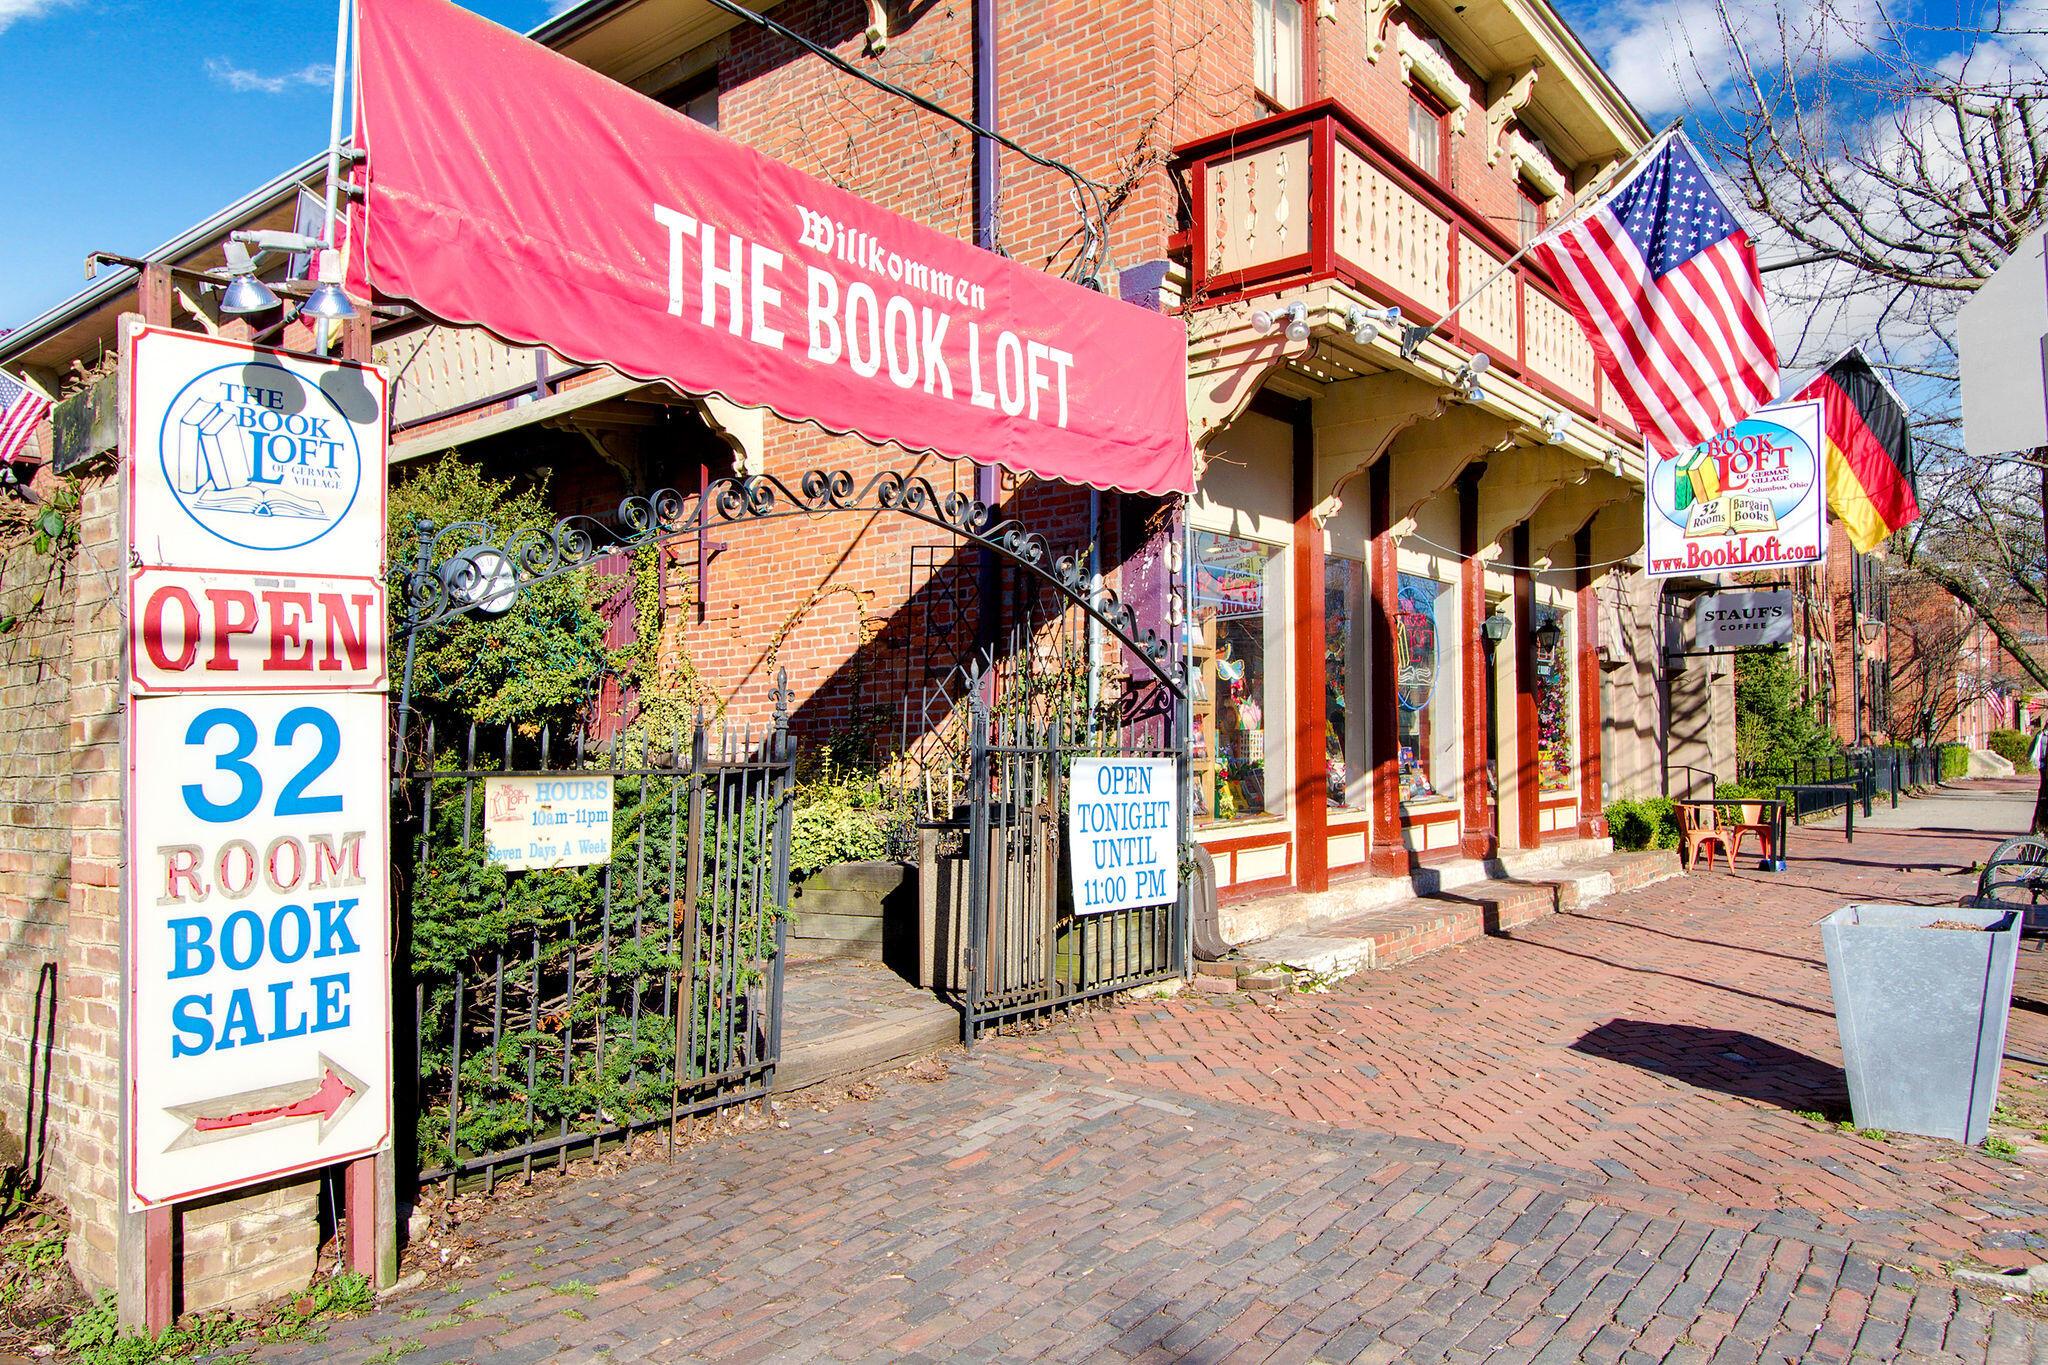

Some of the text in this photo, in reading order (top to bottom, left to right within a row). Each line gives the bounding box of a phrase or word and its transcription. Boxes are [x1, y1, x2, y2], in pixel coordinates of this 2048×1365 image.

[797, 204, 986, 311] Willkommen
[654, 203, 1074, 429] THE BOOK LOFT
[219, 382, 284, 410] THE
[236, 406, 331, 439] BOOK
[247, 430, 345, 485] LOFT
[1708, 432, 1774, 457] BOOK
[272, 464, 342, 479] OF GERMAN
[294, 476, 343, 490] VILLAGE
[1713, 446, 1793, 493] LOFT
[1751, 468, 1789, 478] GERMAN
[1751, 474, 1789, 484] VILLAGE
[1789, 481, 1809, 489] Ohio
[1699, 501, 1719, 517] 32
[1733, 498, 1769, 512] Bargain
[1734, 510, 1769, 522] Books
[1693, 514, 1726, 528] Rooms
[1652, 535, 1818, 572] www.BookLoft.com
[1704, 606, 1783, 622] STAUF'S
[1720, 623, 1767, 631] COFFEE
[143, 585, 373, 672] OPEN
[181, 706, 344, 823] 32
[536, 780, 608, 802] HOURS
[1097, 766, 1153, 795] OPEN
[507, 795, 530, 811] LOFT
[1077, 801, 1170, 833] TONIGHT
[488, 838, 607, 861] Seven Days A Week
[1092, 836, 1157, 869] UNTIL
[156, 830, 367, 907] ROOM
[1084, 869, 1167, 906] 11:00 PM
[167, 898, 360, 980] BOOK
[172, 972, 351, 1058] SALE
